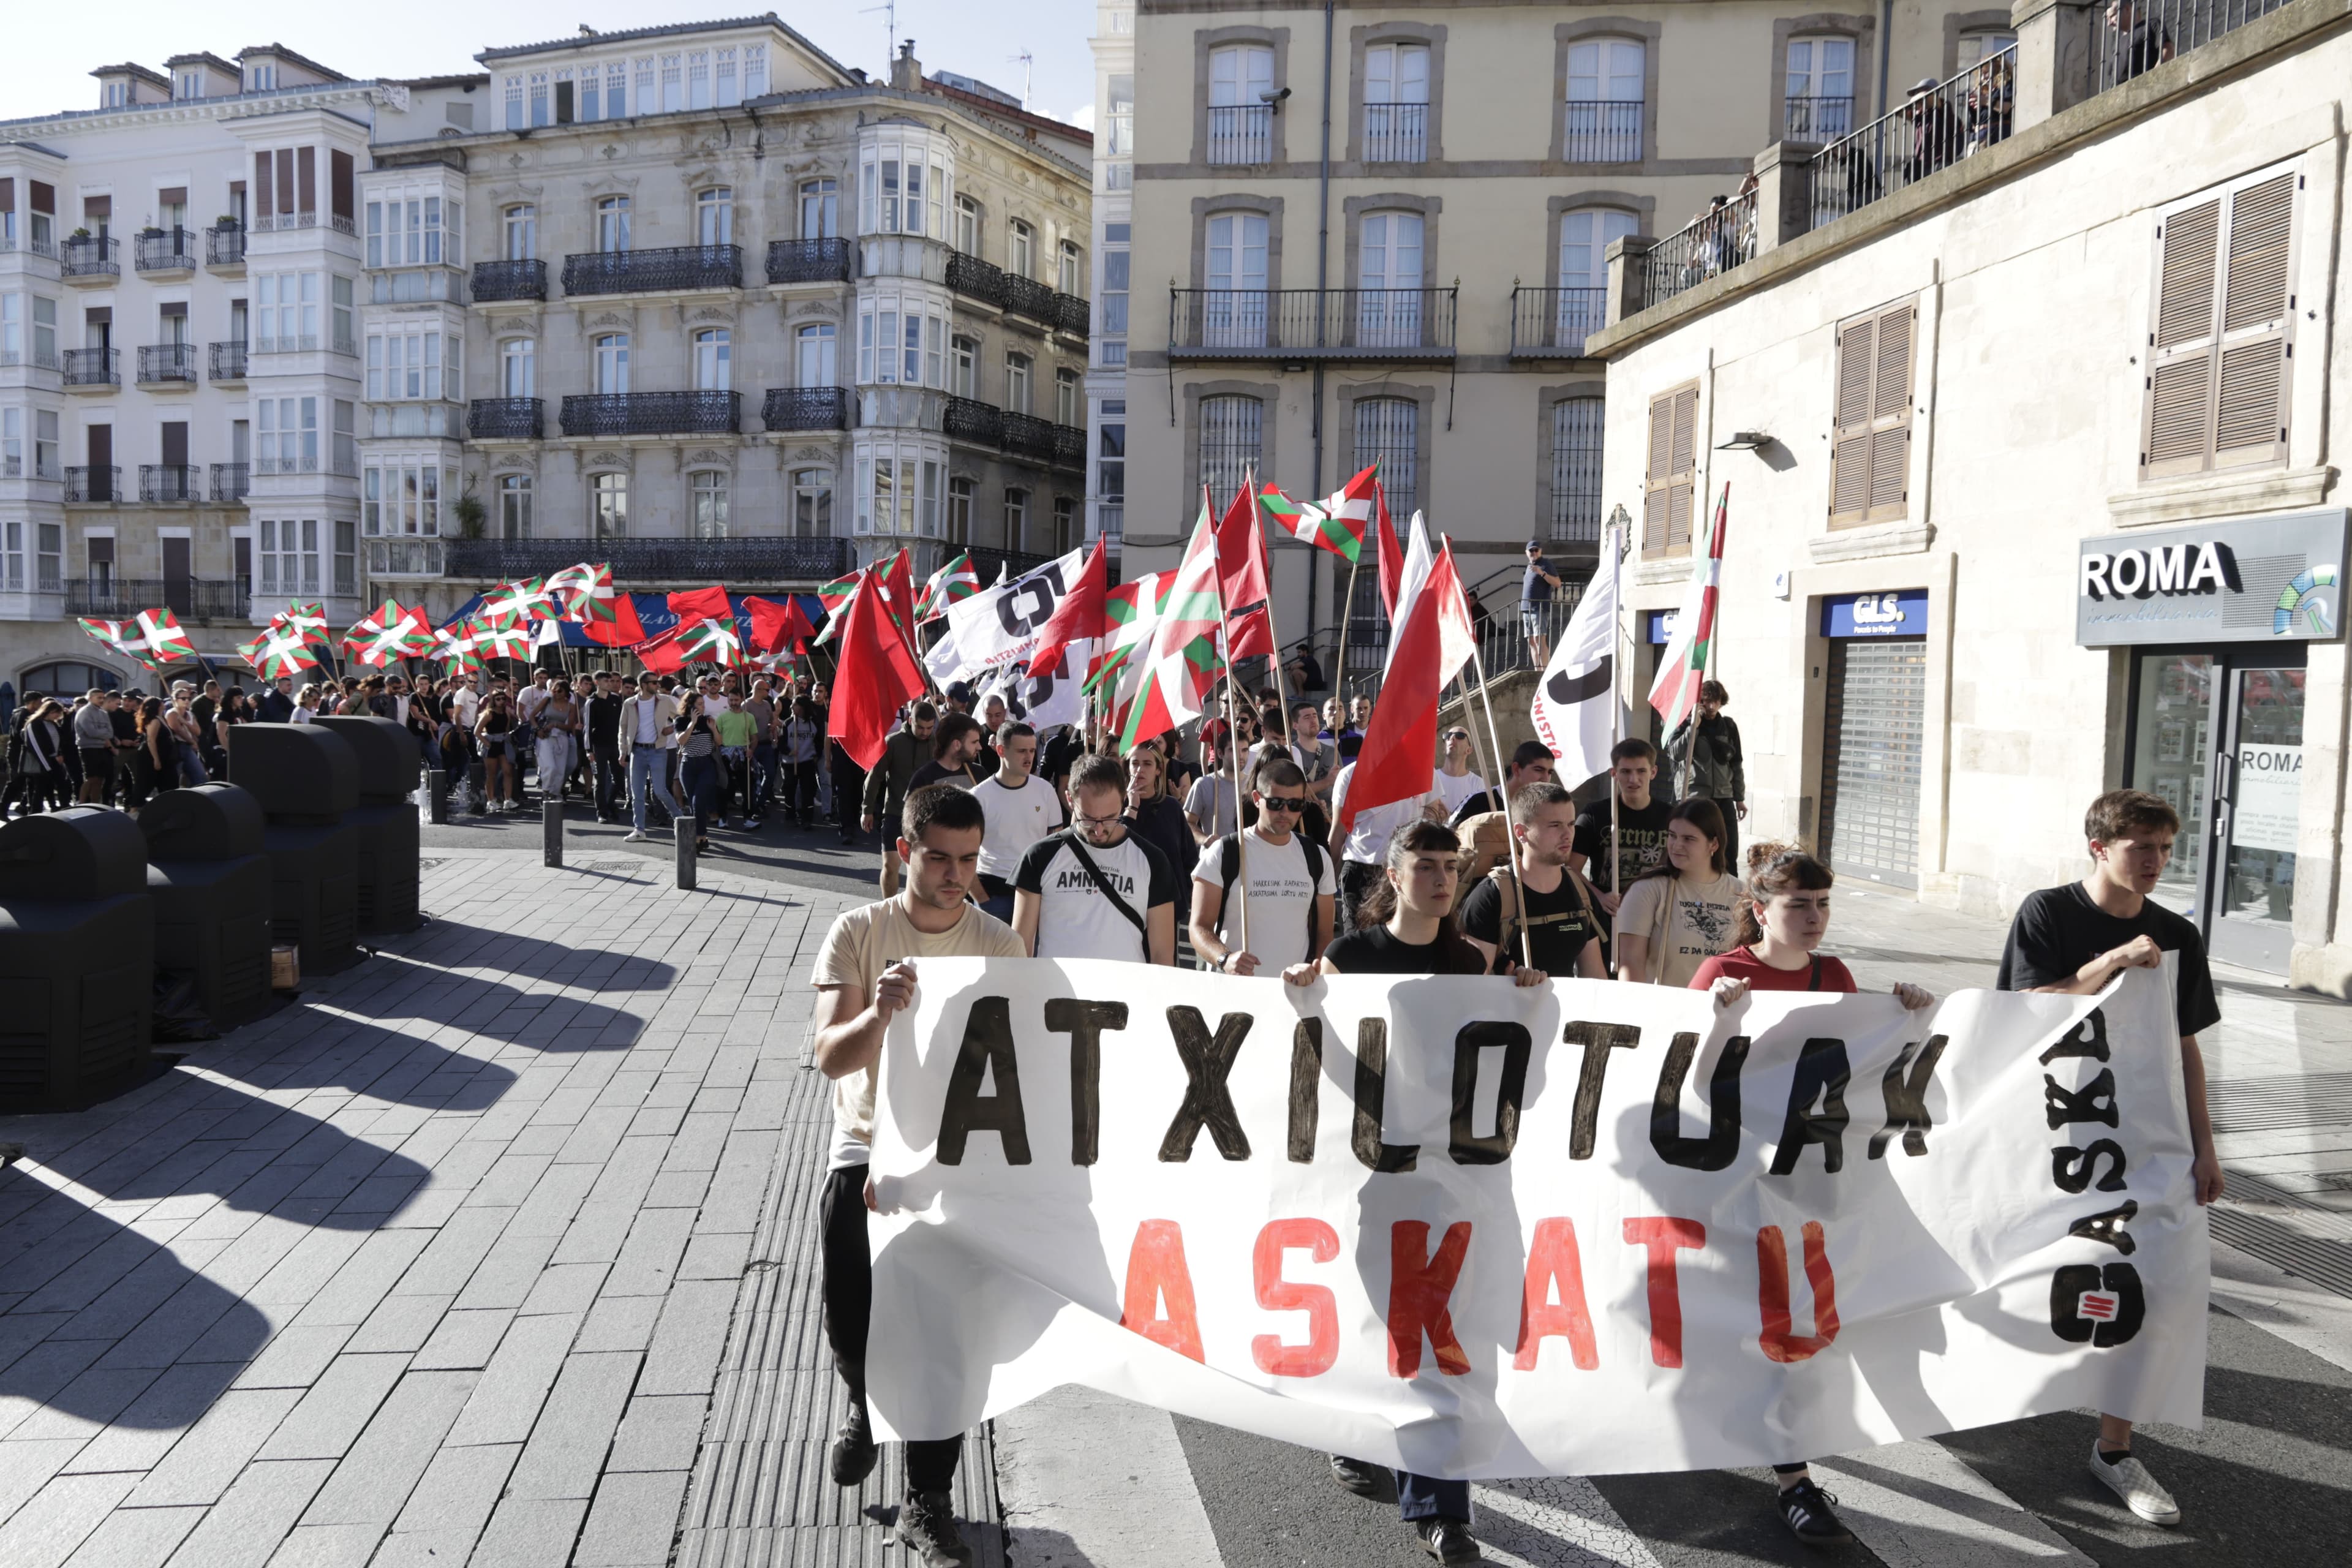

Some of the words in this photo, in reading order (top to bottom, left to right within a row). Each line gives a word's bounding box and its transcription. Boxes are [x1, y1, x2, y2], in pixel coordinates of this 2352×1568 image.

[2081, 541, 2226, 597] ROMA
[935, 996, 1950, 1175] ATXILOTUAK
[1120, 1216, 1841, 1379] ASKATU
